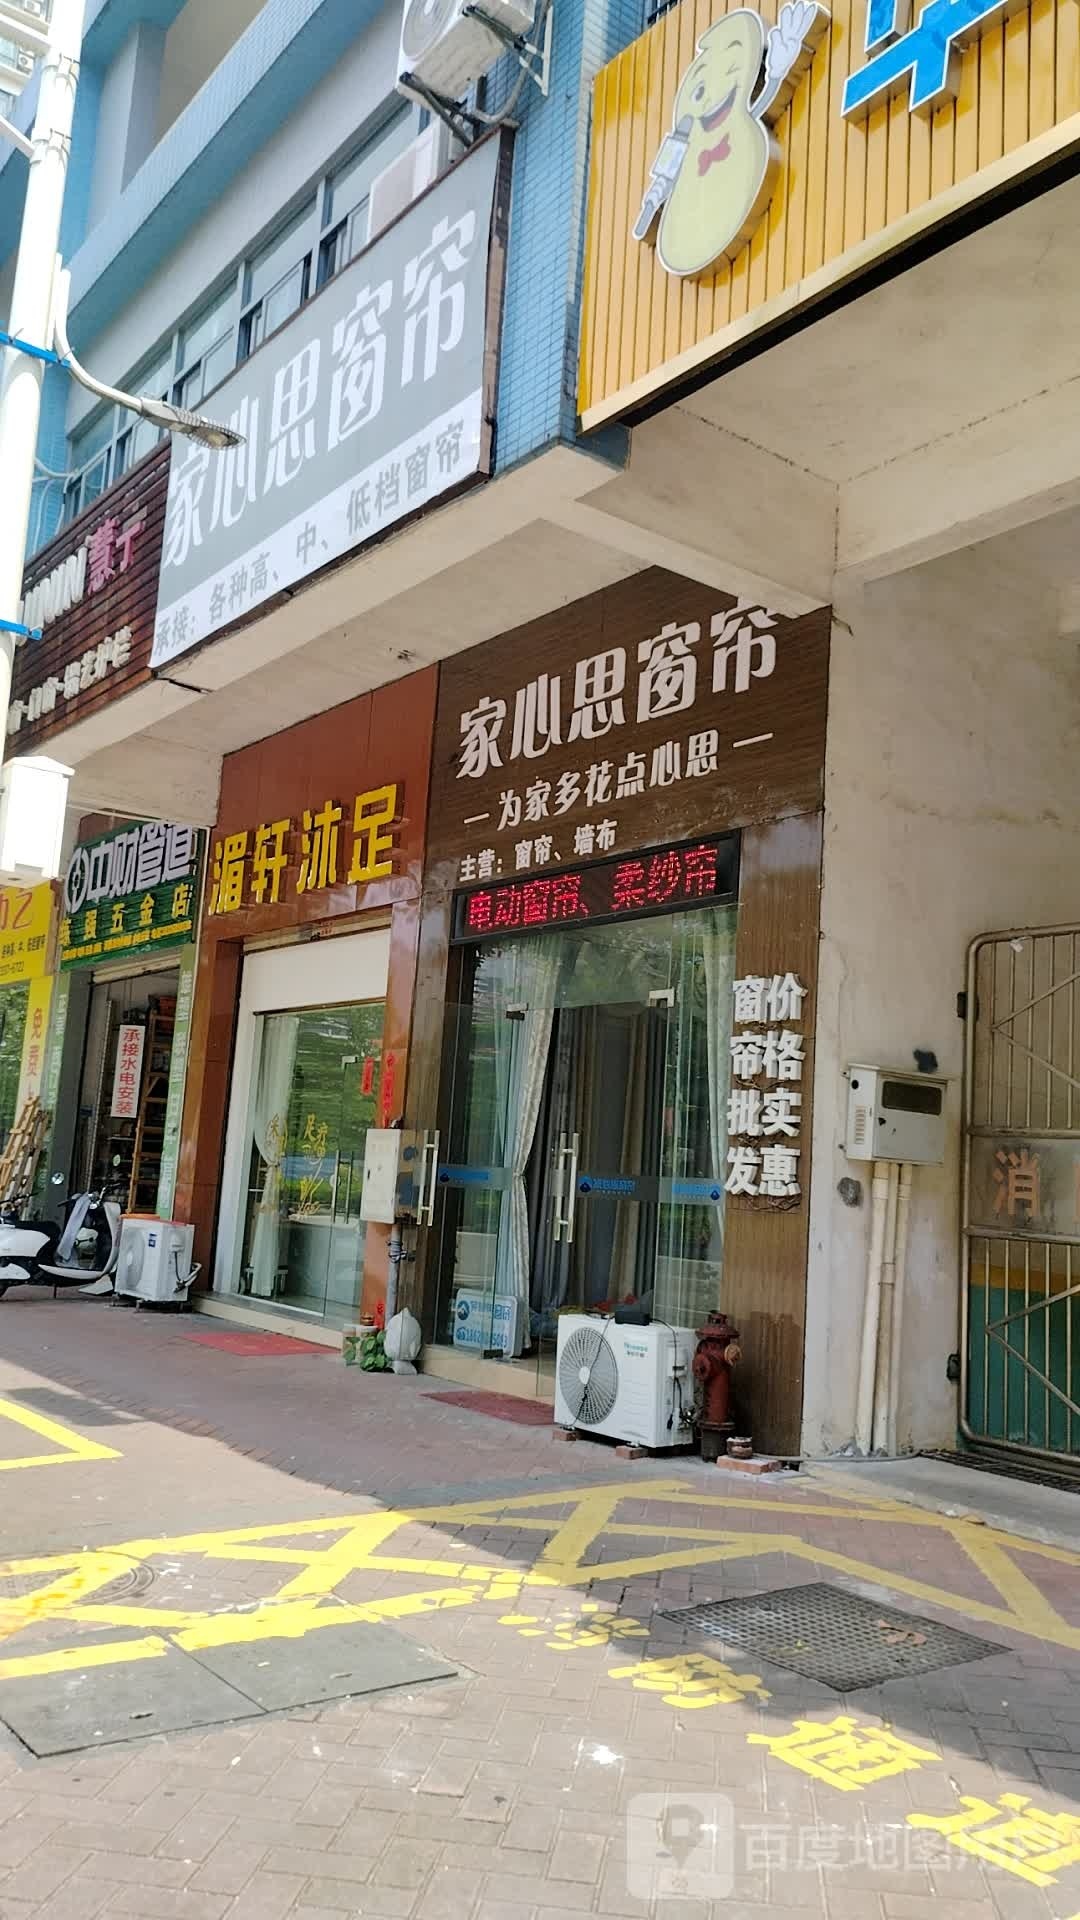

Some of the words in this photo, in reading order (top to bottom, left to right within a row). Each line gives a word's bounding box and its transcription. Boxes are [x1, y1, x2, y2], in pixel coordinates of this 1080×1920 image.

[164, 209, 477, 568] 家心思窗帘
[456, 602, 779, 780] 家心思窗帘
[208, 783, 398, 916] 湄轩沐足
[115, 1028, 141, 1114] 承接水电安装
